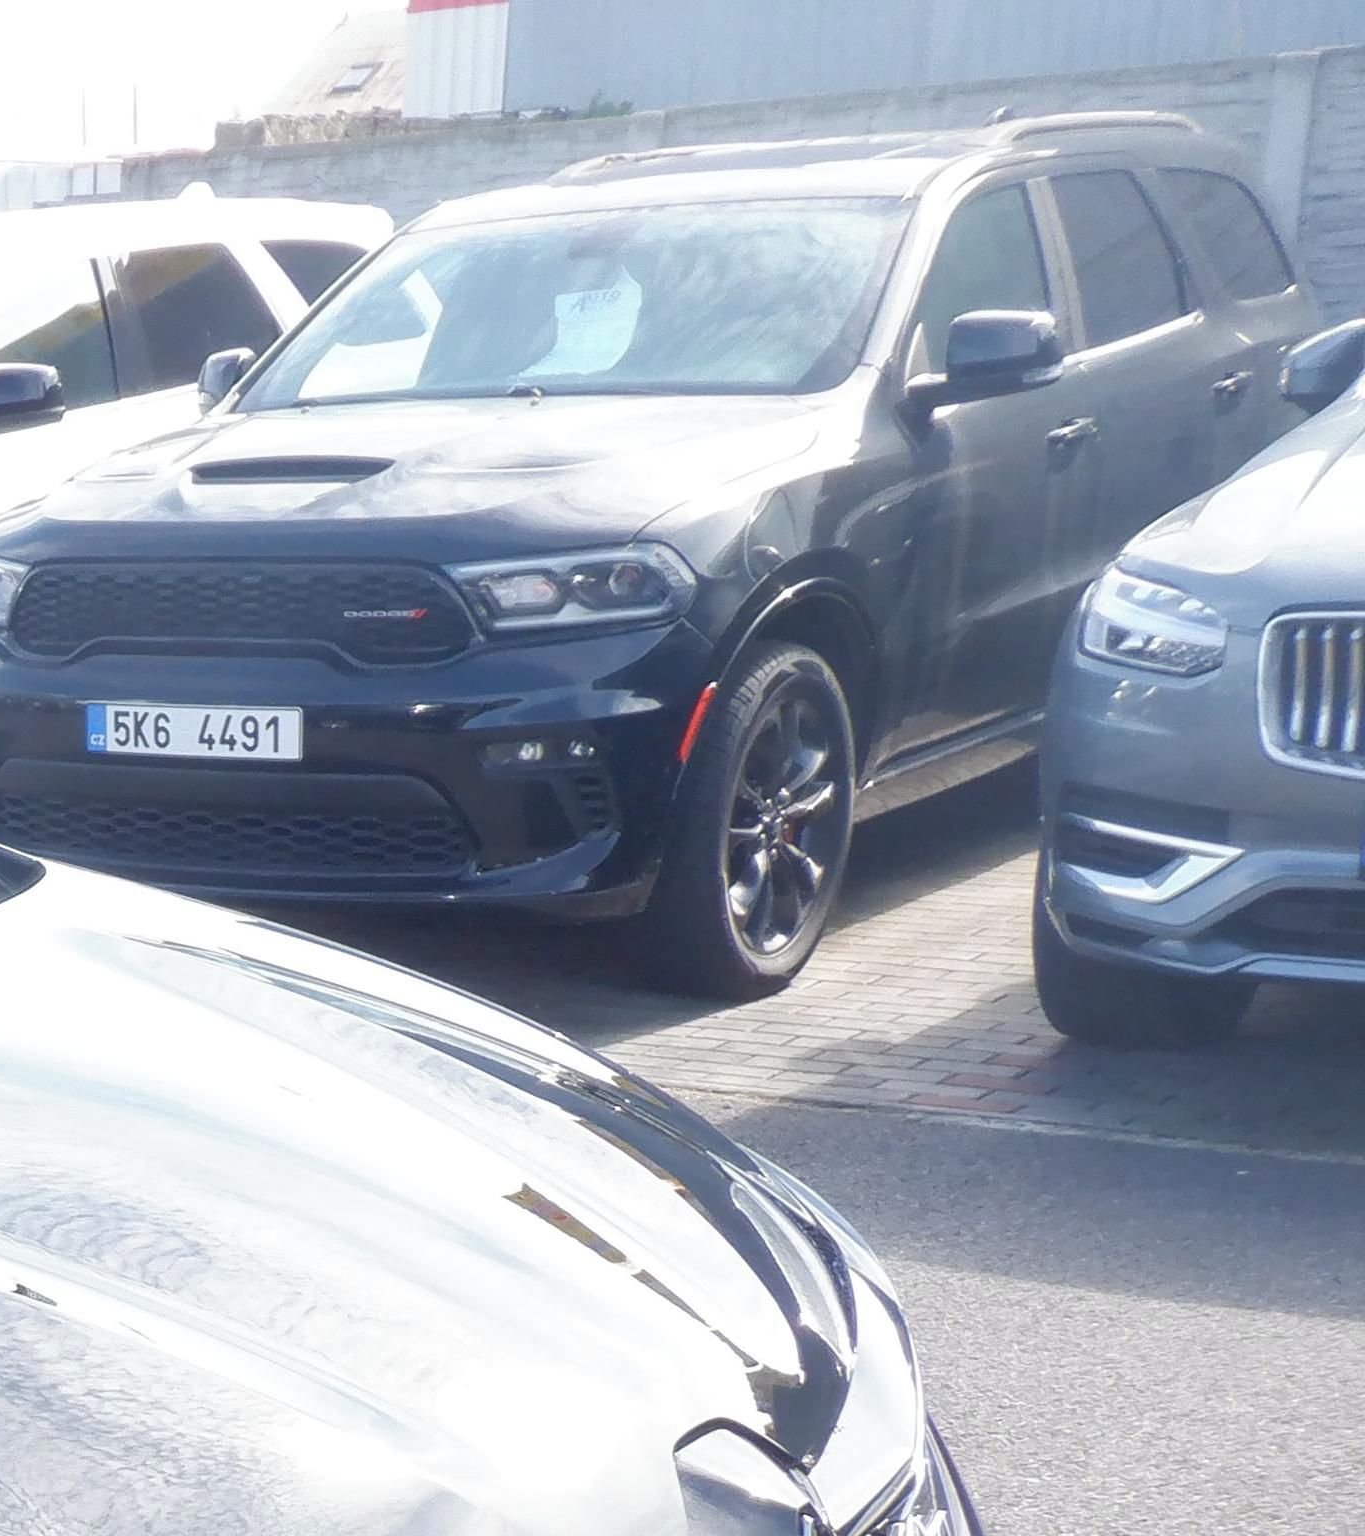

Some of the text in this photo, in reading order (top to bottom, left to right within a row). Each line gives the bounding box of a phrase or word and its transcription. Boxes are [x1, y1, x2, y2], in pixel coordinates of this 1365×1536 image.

[90, 733, 105, 746] CZ
[113, 710, 280, 753] 5K6 4491
